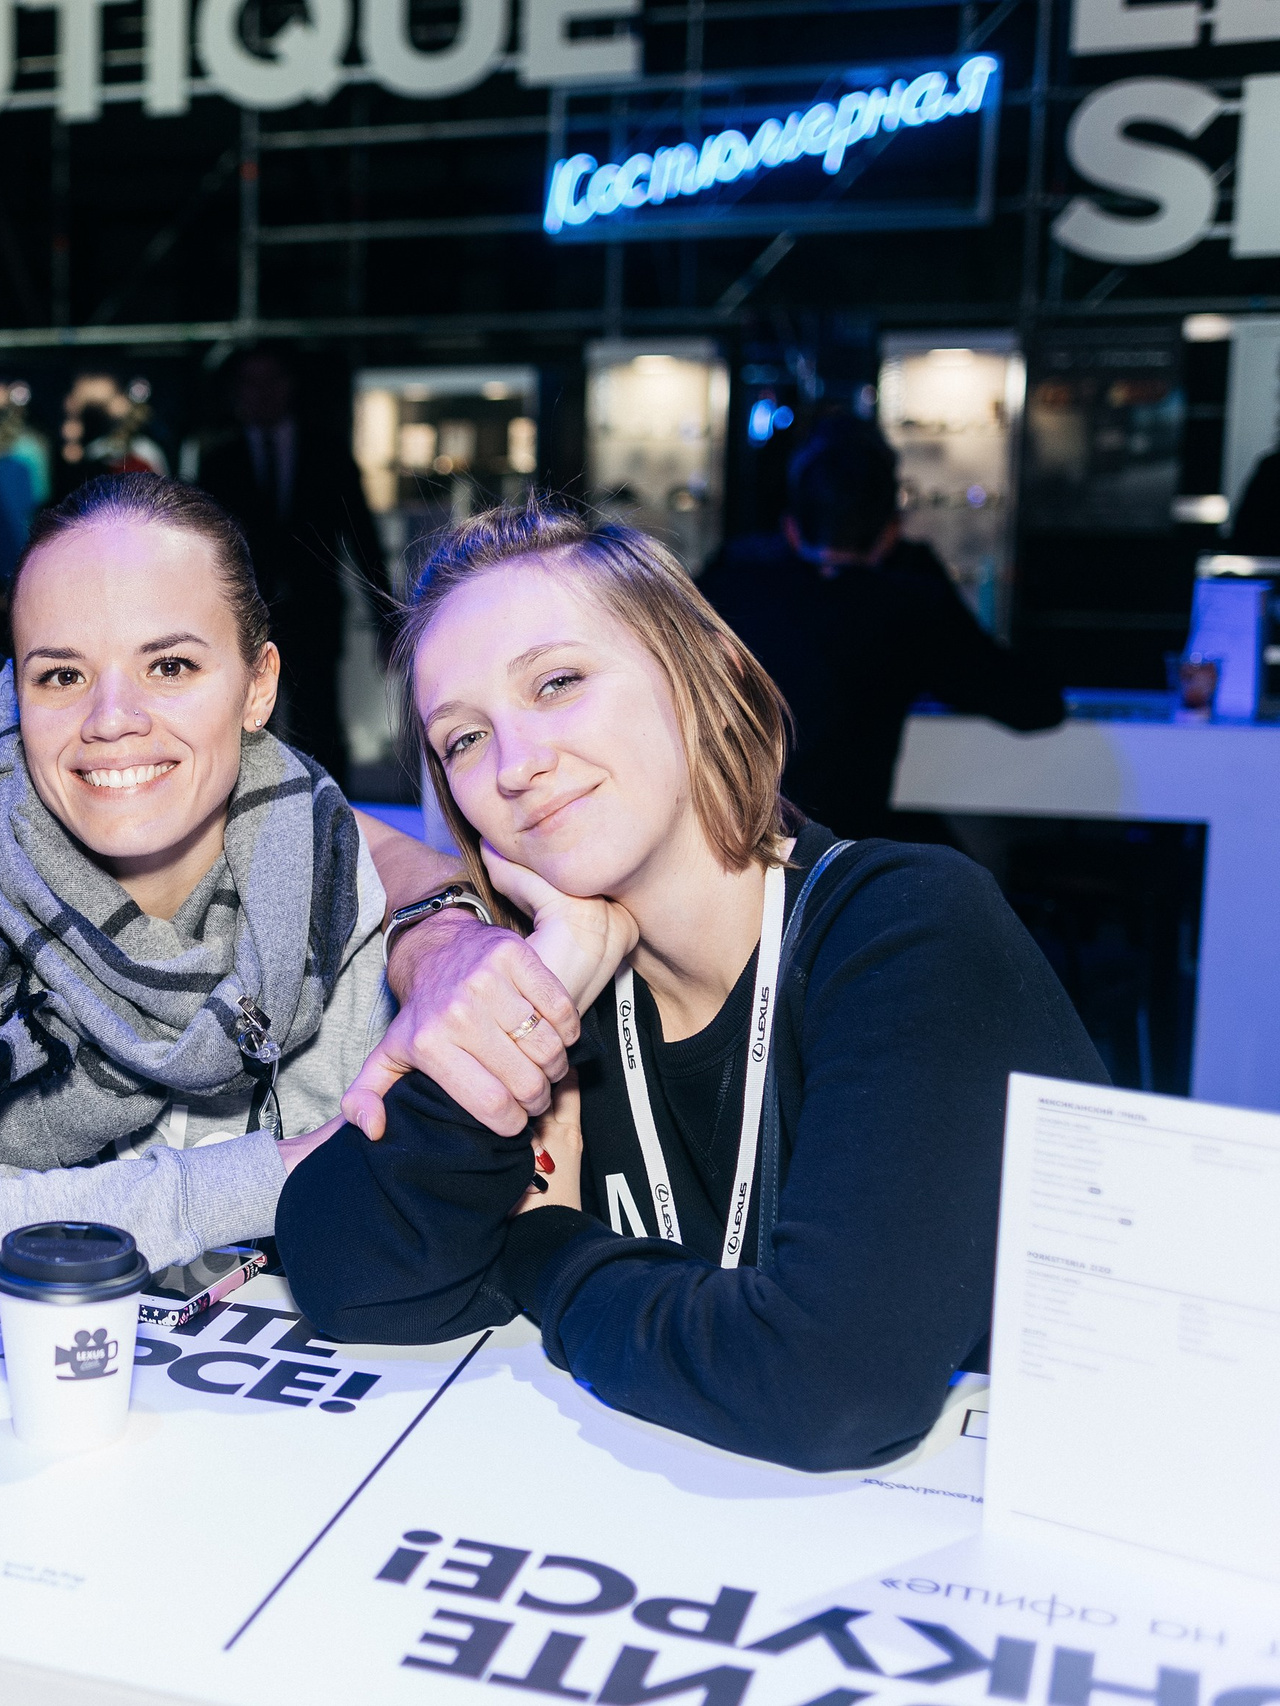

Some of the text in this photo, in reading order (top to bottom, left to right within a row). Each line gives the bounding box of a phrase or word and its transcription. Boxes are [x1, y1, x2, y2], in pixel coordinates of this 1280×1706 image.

[543, 56, 998, 234] Костюмерная
[757, 986, 770, 1042] LEXUS
[622, 1018, 636, 1070] LEXUS
[732, 1182, 747, 1237] LEXUS
[76, 1347, 106, 1362] LEXUS
